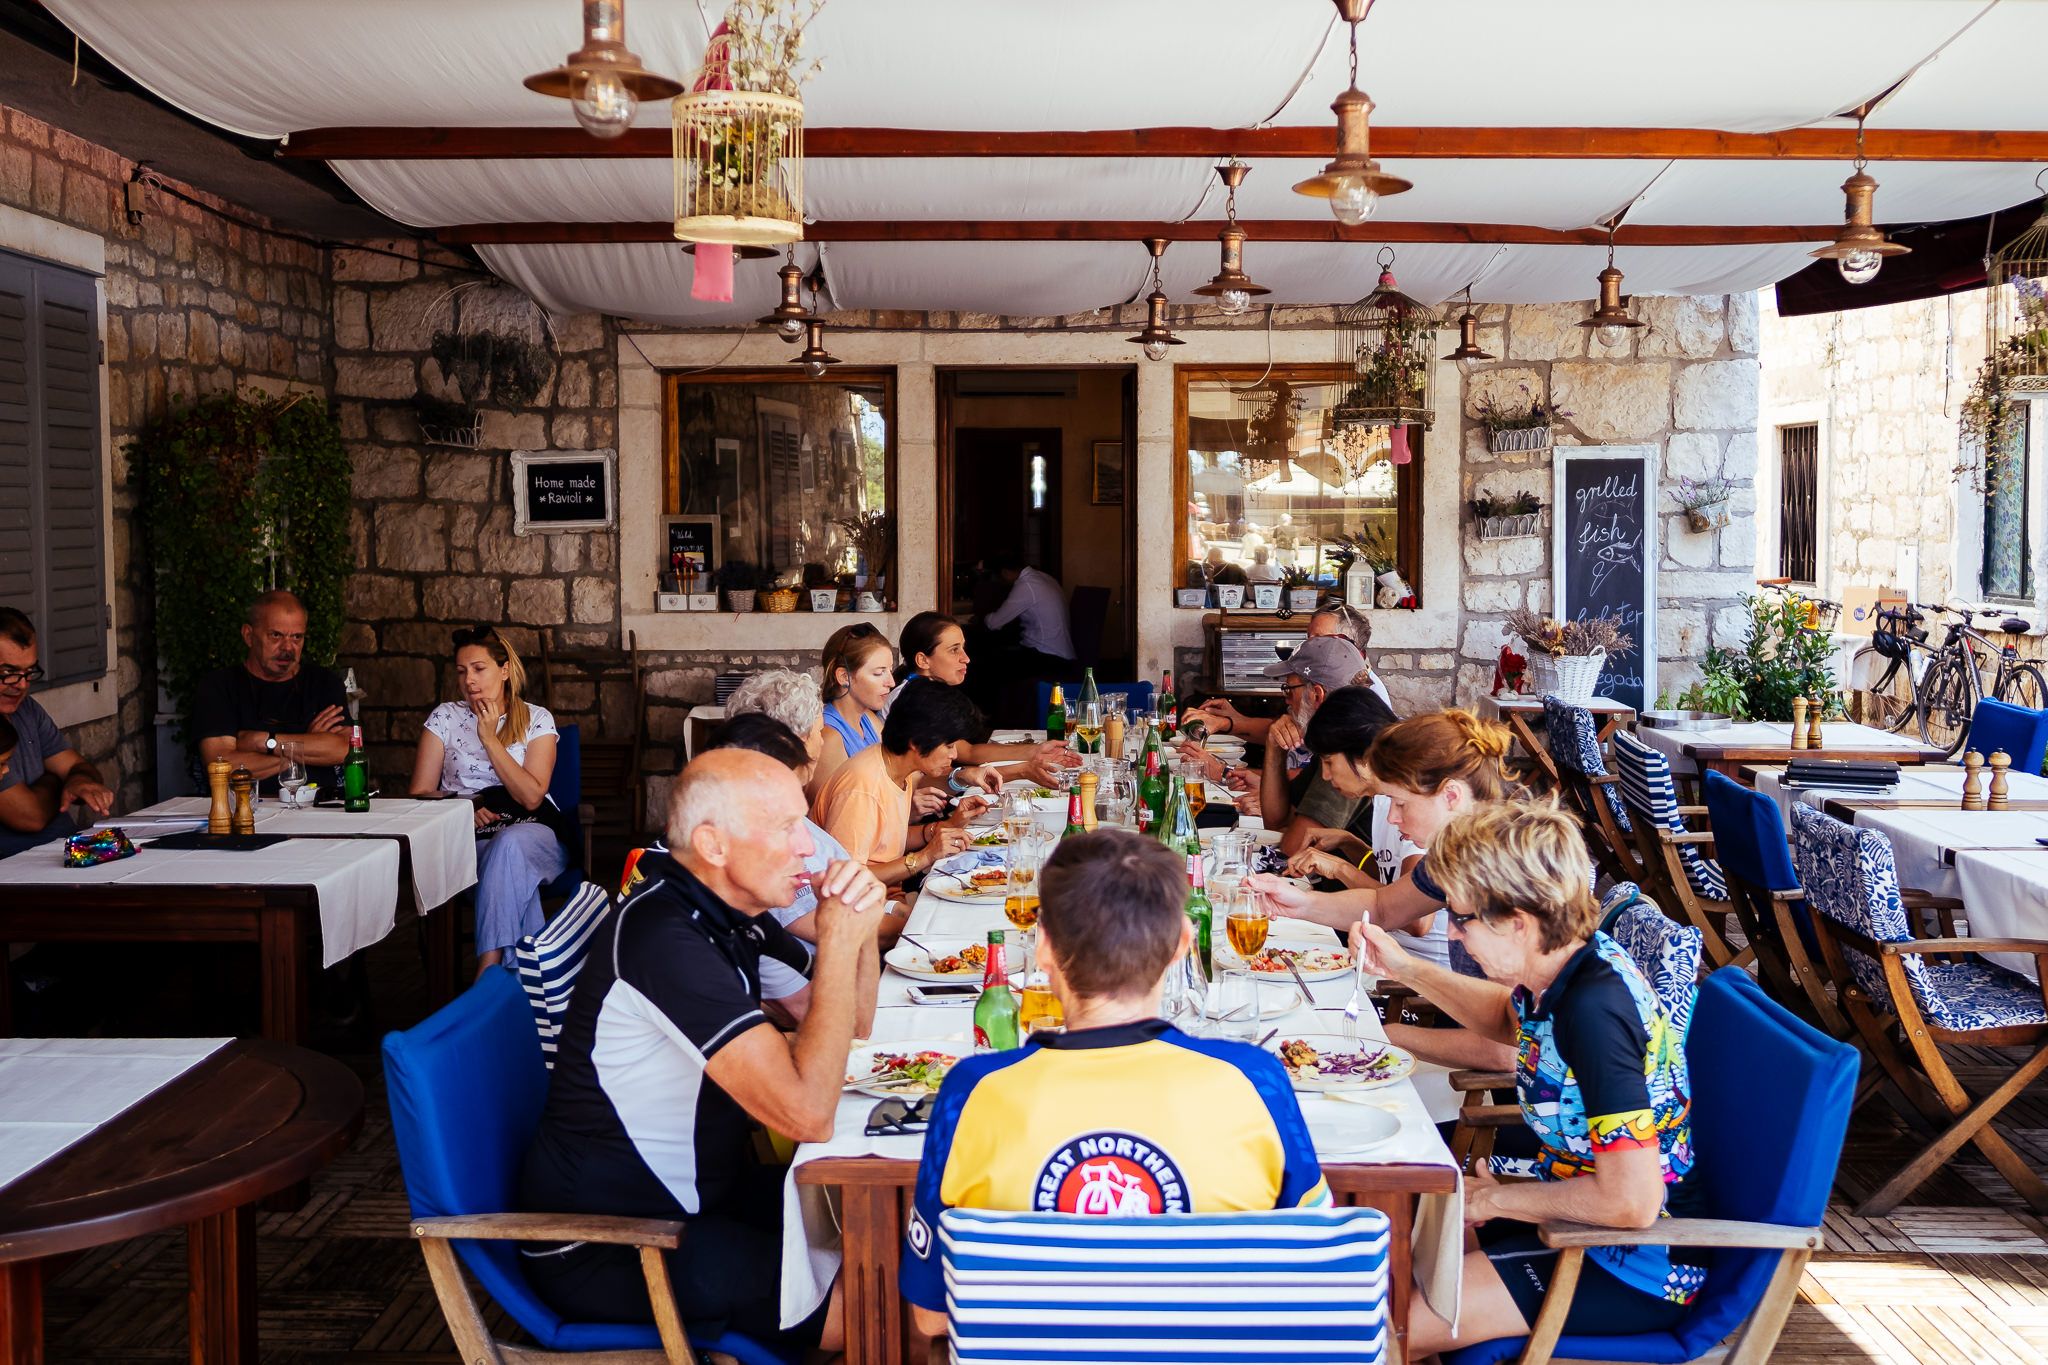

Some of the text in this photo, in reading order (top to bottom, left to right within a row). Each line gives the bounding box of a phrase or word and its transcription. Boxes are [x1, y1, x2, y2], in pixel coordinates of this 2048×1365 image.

[535, 475, 596, 489] Home made
[548, 492, 582, 504] Ravioli
[1575, 473, 1638, 513] grilled
[1578, 513, 1627, 553] fish
[1038, 1136, 1184, 1213] REAT NORTHERN
[1523, 1263, 1545, 1292] TERRY
